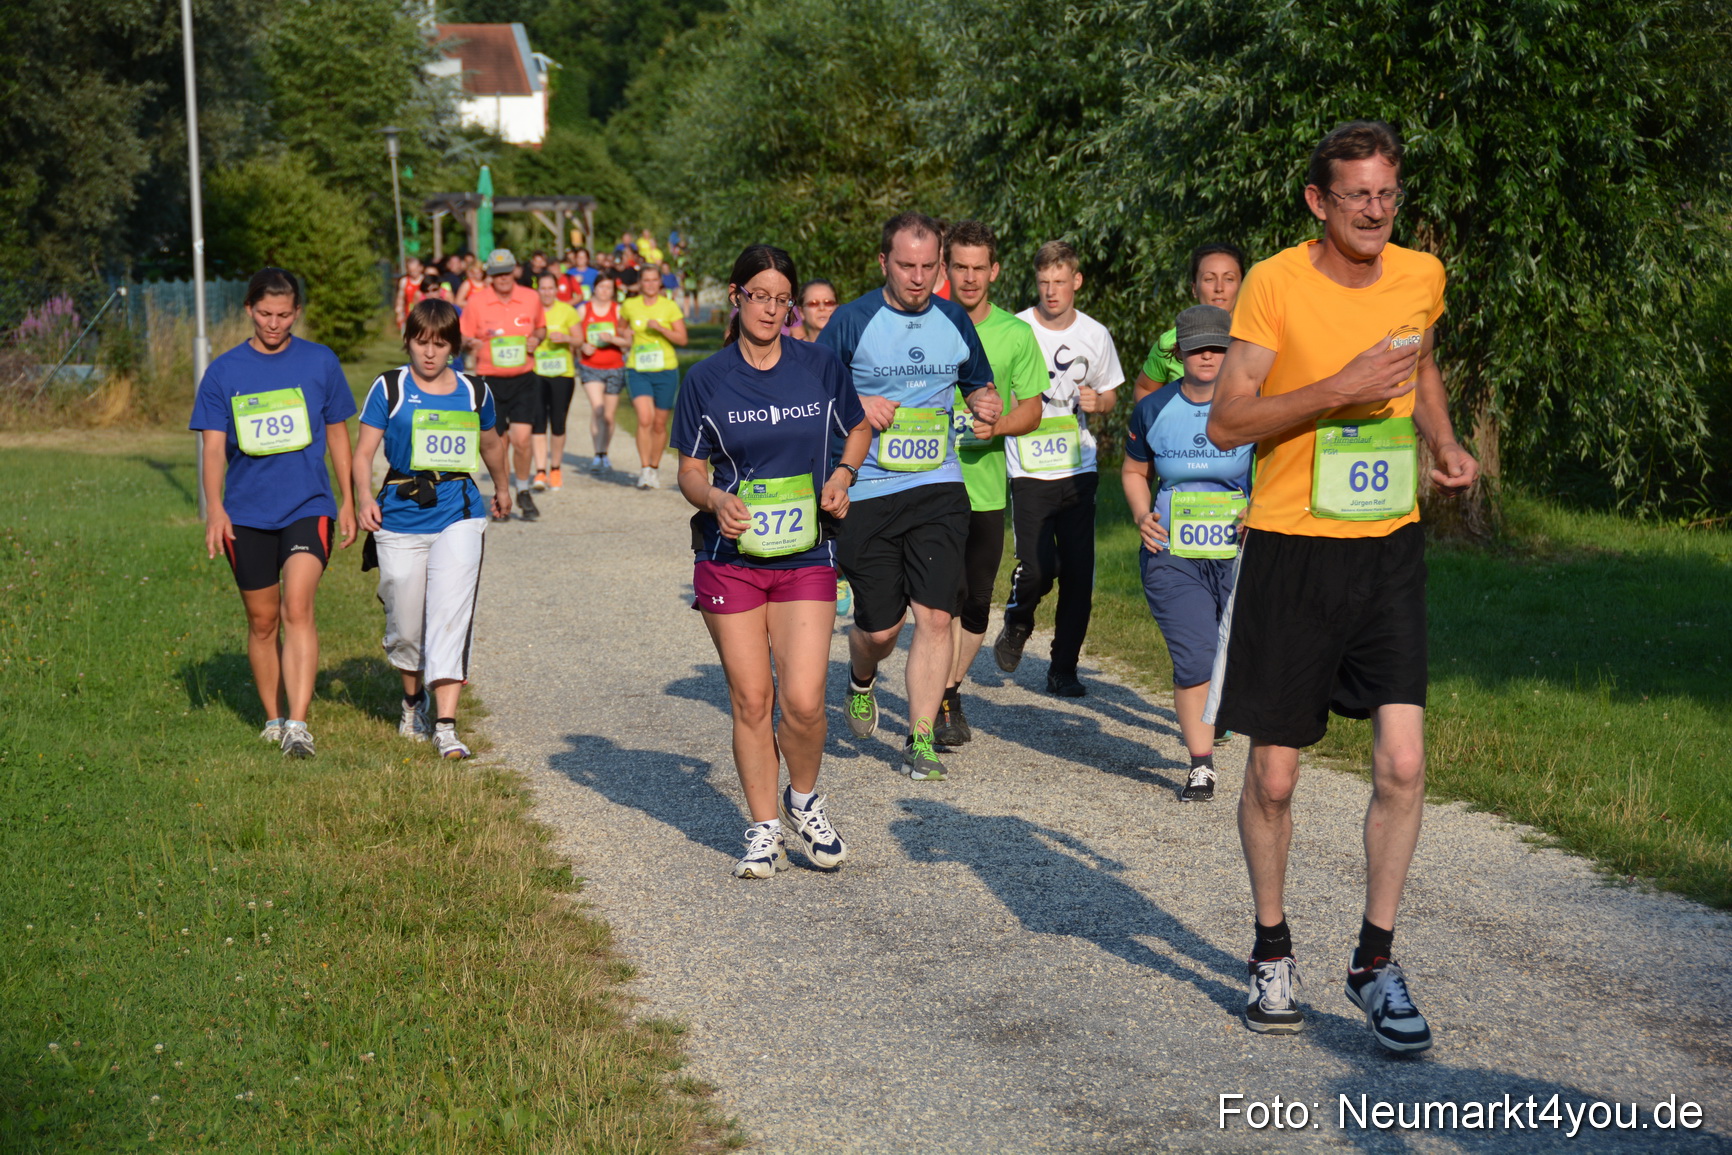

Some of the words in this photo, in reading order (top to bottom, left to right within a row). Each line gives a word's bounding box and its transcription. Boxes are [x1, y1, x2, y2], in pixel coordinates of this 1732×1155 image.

[498, 348, 519, 359] 457
[873, 364, 957, 377] SCHABMÜLLER
[906, 380, 927, 388] TEAM
[728, 409, 768, 424] EURO
[782, 402, 821, 420] POLES
[250, 415, 294, 438] 789
[426, 435, 466, 455] 808
[887, 438, 939, 459] 6088
[1031, 437, 1068, 457] 346
[1162, 448, 1238, 459] SCHABMÜLLER
[1349, 460, 1389, 493] 68
[1350, 499, 1373, 508] Jürgen
[753, 508, 803, 536] 372
[1180, 523, 1238, 546] 6089
